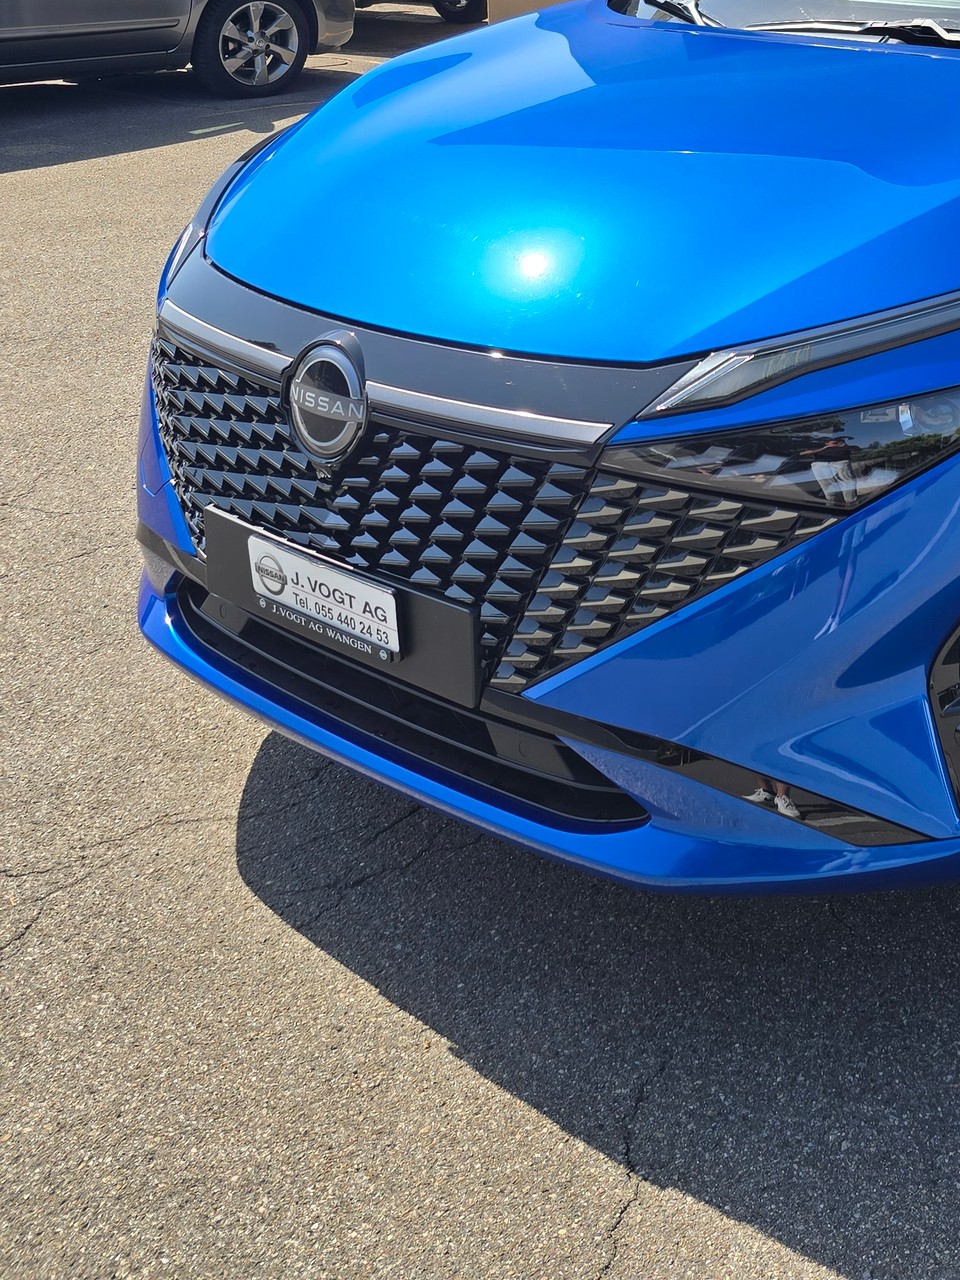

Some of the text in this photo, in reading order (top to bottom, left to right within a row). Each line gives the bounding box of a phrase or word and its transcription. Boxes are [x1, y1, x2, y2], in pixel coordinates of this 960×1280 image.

[289, 383, 364, 419] NISSAN
[257, 566, 286, 583] NISSAN
[292, 591, 390, 645] Tel. 055 440 24 53
[362, 601, 388, 624] AG
[308, 621, 323, 633] AG
[325, 627, 372, 654] WANGEN
